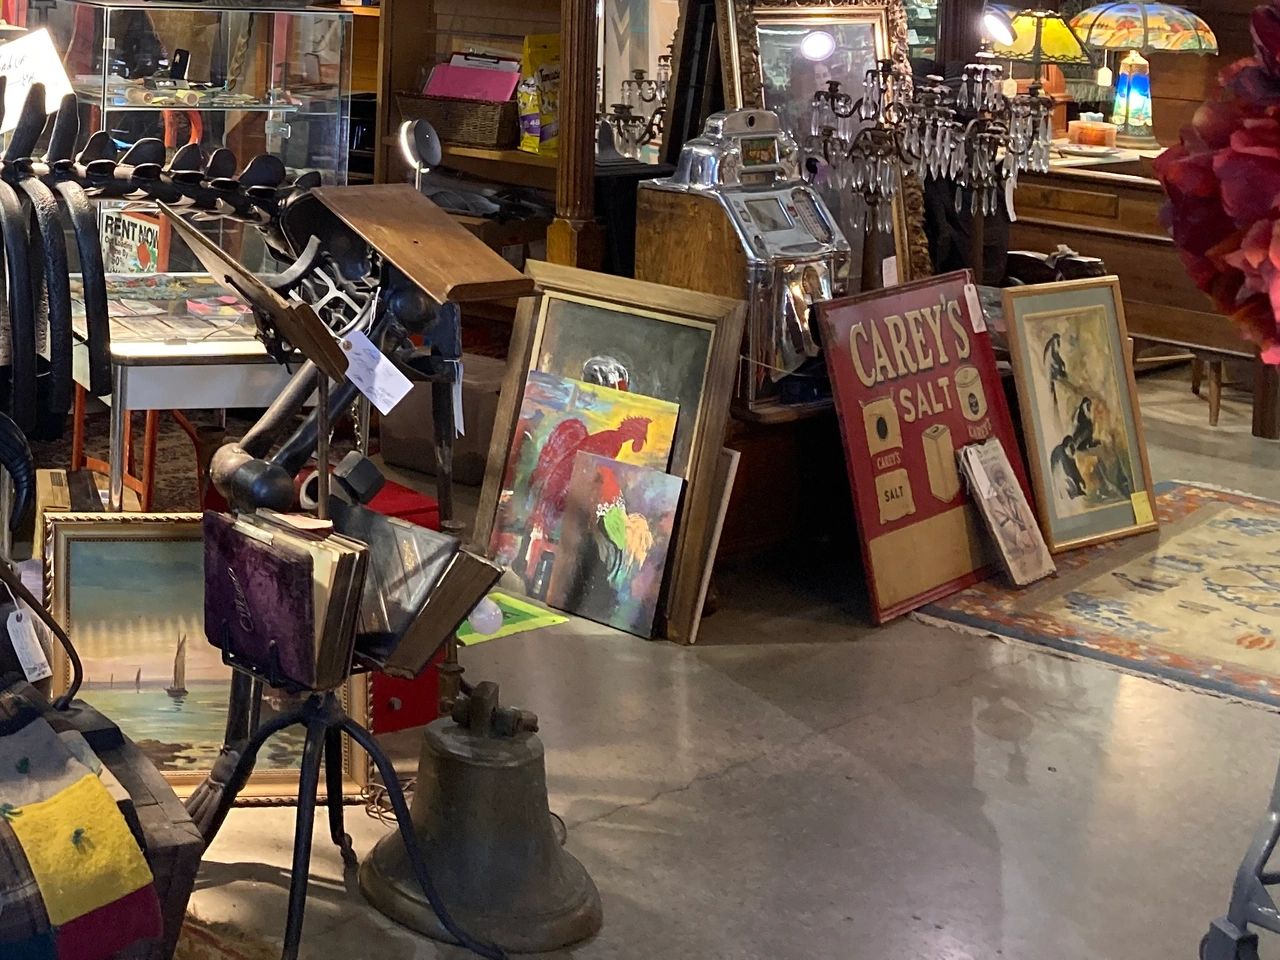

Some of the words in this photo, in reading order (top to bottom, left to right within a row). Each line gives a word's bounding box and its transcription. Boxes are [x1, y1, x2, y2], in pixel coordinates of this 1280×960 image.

[105, 215, 137, 241] RENT
[849, 294, 971, 388] CAREY'S
[899, 376, 952, 424] SALT
[884, 485, 904, 502] SALT
